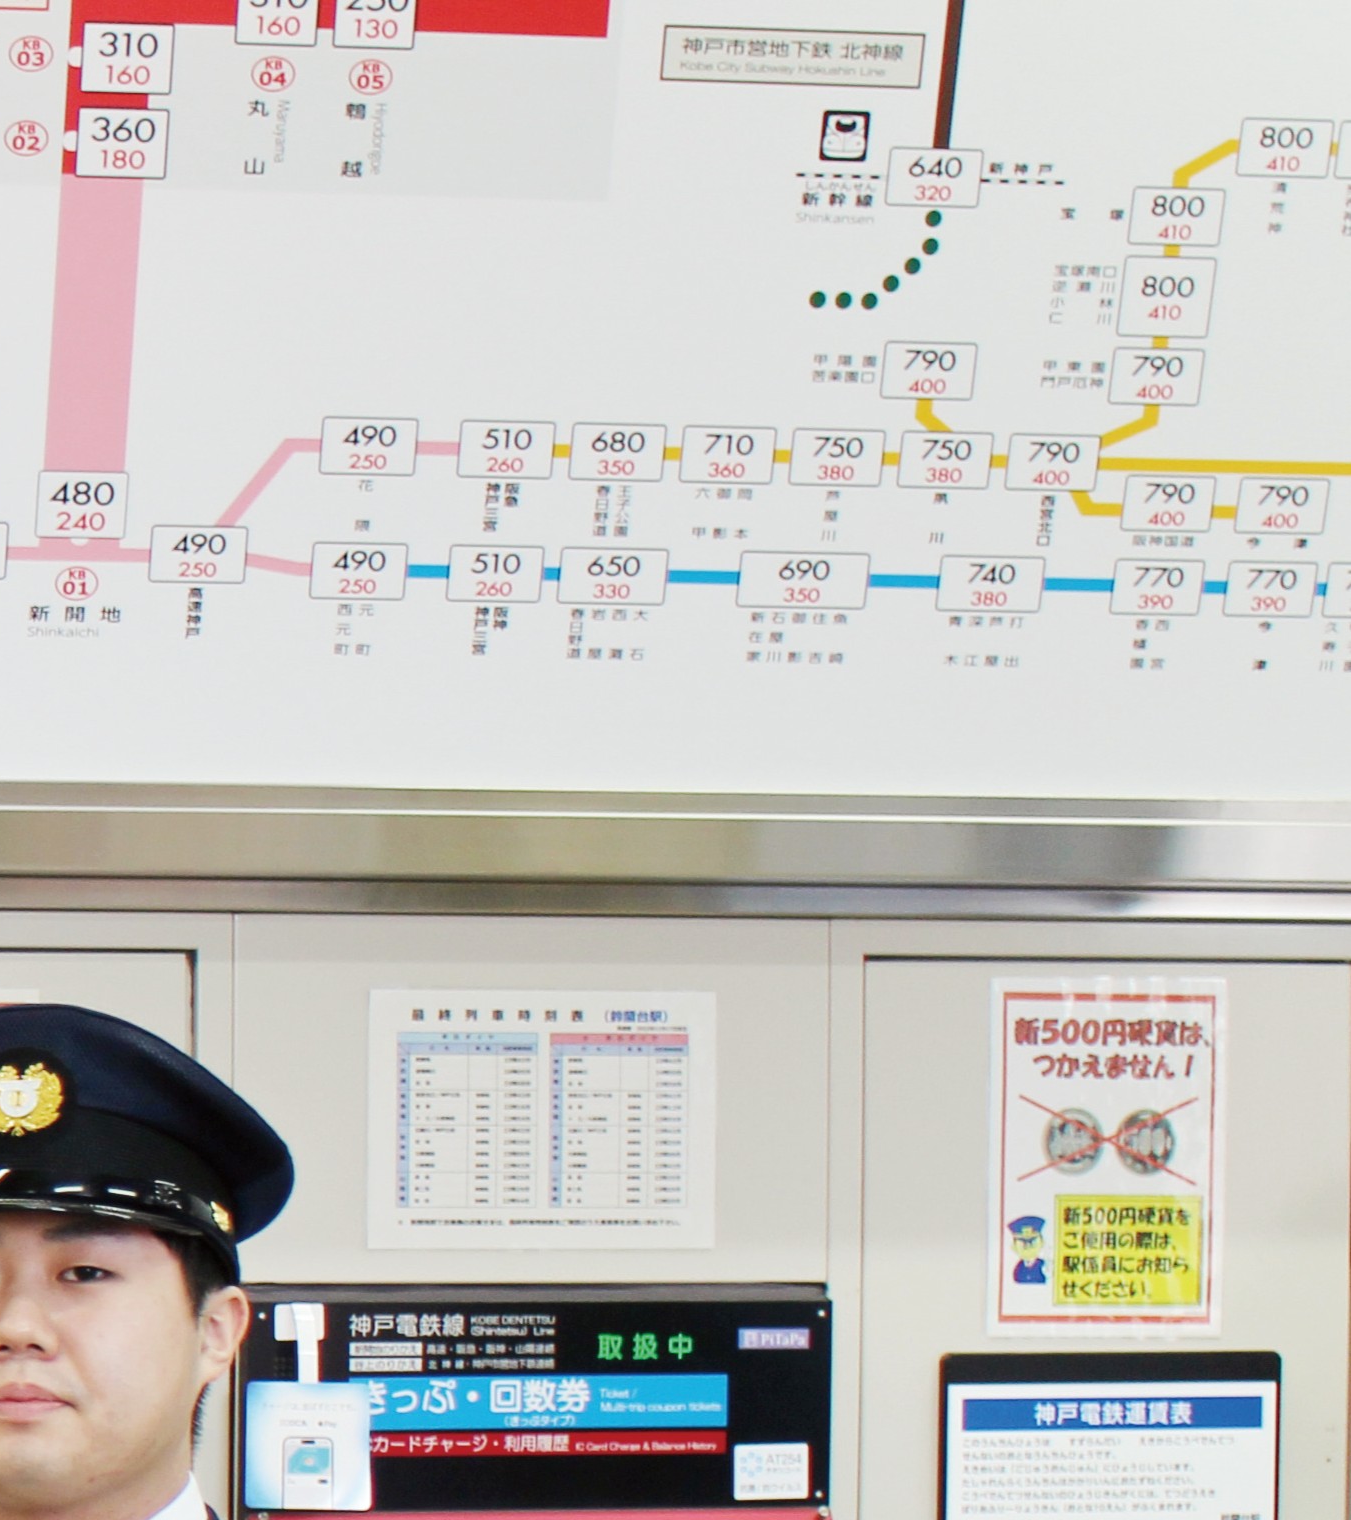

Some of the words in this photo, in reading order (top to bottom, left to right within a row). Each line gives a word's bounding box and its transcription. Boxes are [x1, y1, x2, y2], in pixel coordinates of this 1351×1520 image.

[258, 16, 300, 36] 160
[356, 19, 398, 39] 130
[99, 32, 158, 58] 310
[681, 37, 833, 58] 神戸市営地下鉄
[839, 43, 904, 61] 北神線
[17, 51, 44, 66] 03
[107, 65, 150, 85] 160
[92, 117, 156, 143] 360
[1260, 127, 1313, 149] 800
[12, 135, 41, 152] 02
[102, 150, 145, 169] 180
[909, 157, 962, 178] 640
[916, 186, 951, 200] 320
[1151, 195, 1205, 217] 800
[1159, 226, 1191, 239] 410
[1141, 276, 1194, 297] 800
[905, 350, 956, 371] 790
[1134, 356, 1183, 377] 790
[909, 379, 945, 393] 400
[343, 425, 397, 447] 490
[482, 429, 532, 450] 510
[592, 432, 645, 453] 680
[706, 434, 754, 455] 710
[815, 437, 864, 458] 750
[923, 439, 972, 460] 750
[1030, 442, 1080, 463] 790
[599, 460, 634, 475] 350
[1033, 471, 1069, 484] 400
[50, 481, 115, 506] 480
[1146, 483, 1195, 504] 790
[1260, 486, 1309, 506] 790
[57, 512, 105, 531] 240
[172, 534, 226, 555] 490
[333, 551, 386, 572] 490
[471, 553, 521, 574] 510
[588, 556, 640, 577] 650
[779, 560, 830, 581] 690
[969, 564, 1016, 584] 740
[1135, 567, 1184, 588] 770
[1248, 569, 1297, 589] 770
[594, 584, 630, 598] 330
[972, 592, 1007, 606] 380
[1257, 597, 1285, 609] 390
[29, 605, 121, 623] 新開地
[1014, 1017, 1211, 1048] 新500円硬貨は、
[1034, 1054, 1195, 1079] つかえません！
[1063, 1207, 1190, 1227] 新500円硬貨を
[1063, 1231, 1177, 1251] ご使用の際は、
[1063, 1255, 1190, 1274] 駅係員にお知ら
[349, 1314, 465, 1337] 神戸電鉄線
[470, 1315, 501, 1325] KOBE
[501, 1316, 556, 1325] DENTETSU
[597, 1333, 693, 1360] 取扱中
[759, 1332, 807, 1348] PiTaPa
[1034, 1402, 1192, 1426] 神戸電鉄運賃表
[369, 1435, 570, 1453] カードチャージ・利用履歴
